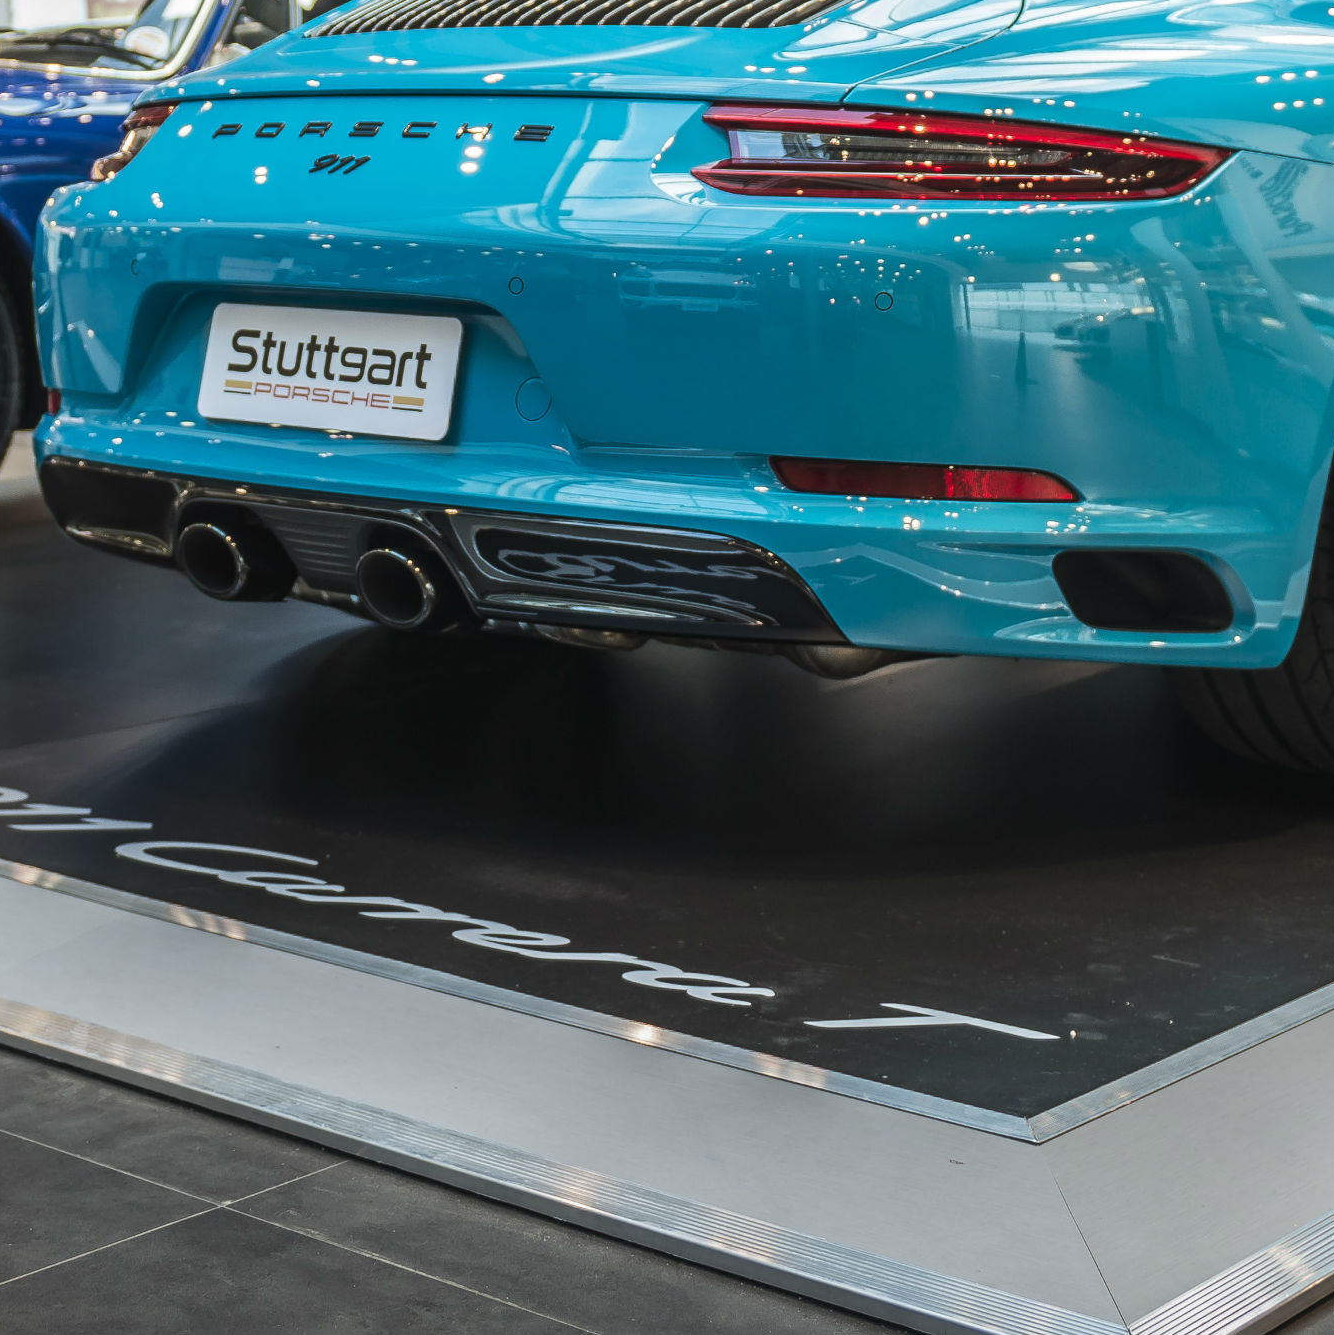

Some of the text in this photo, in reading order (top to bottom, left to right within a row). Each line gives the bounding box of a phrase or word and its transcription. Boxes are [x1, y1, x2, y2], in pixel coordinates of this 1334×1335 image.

[212, 120, 555, 143] PORSCHE
[308, 153, 372, 175] 911
[227, 328, 432, 389] Stuttgart
[254, 382, 391, 409] PORSCHE
[115, 841, 775, 1006] Carrera
[803, 1002, 1060, 1040] T
